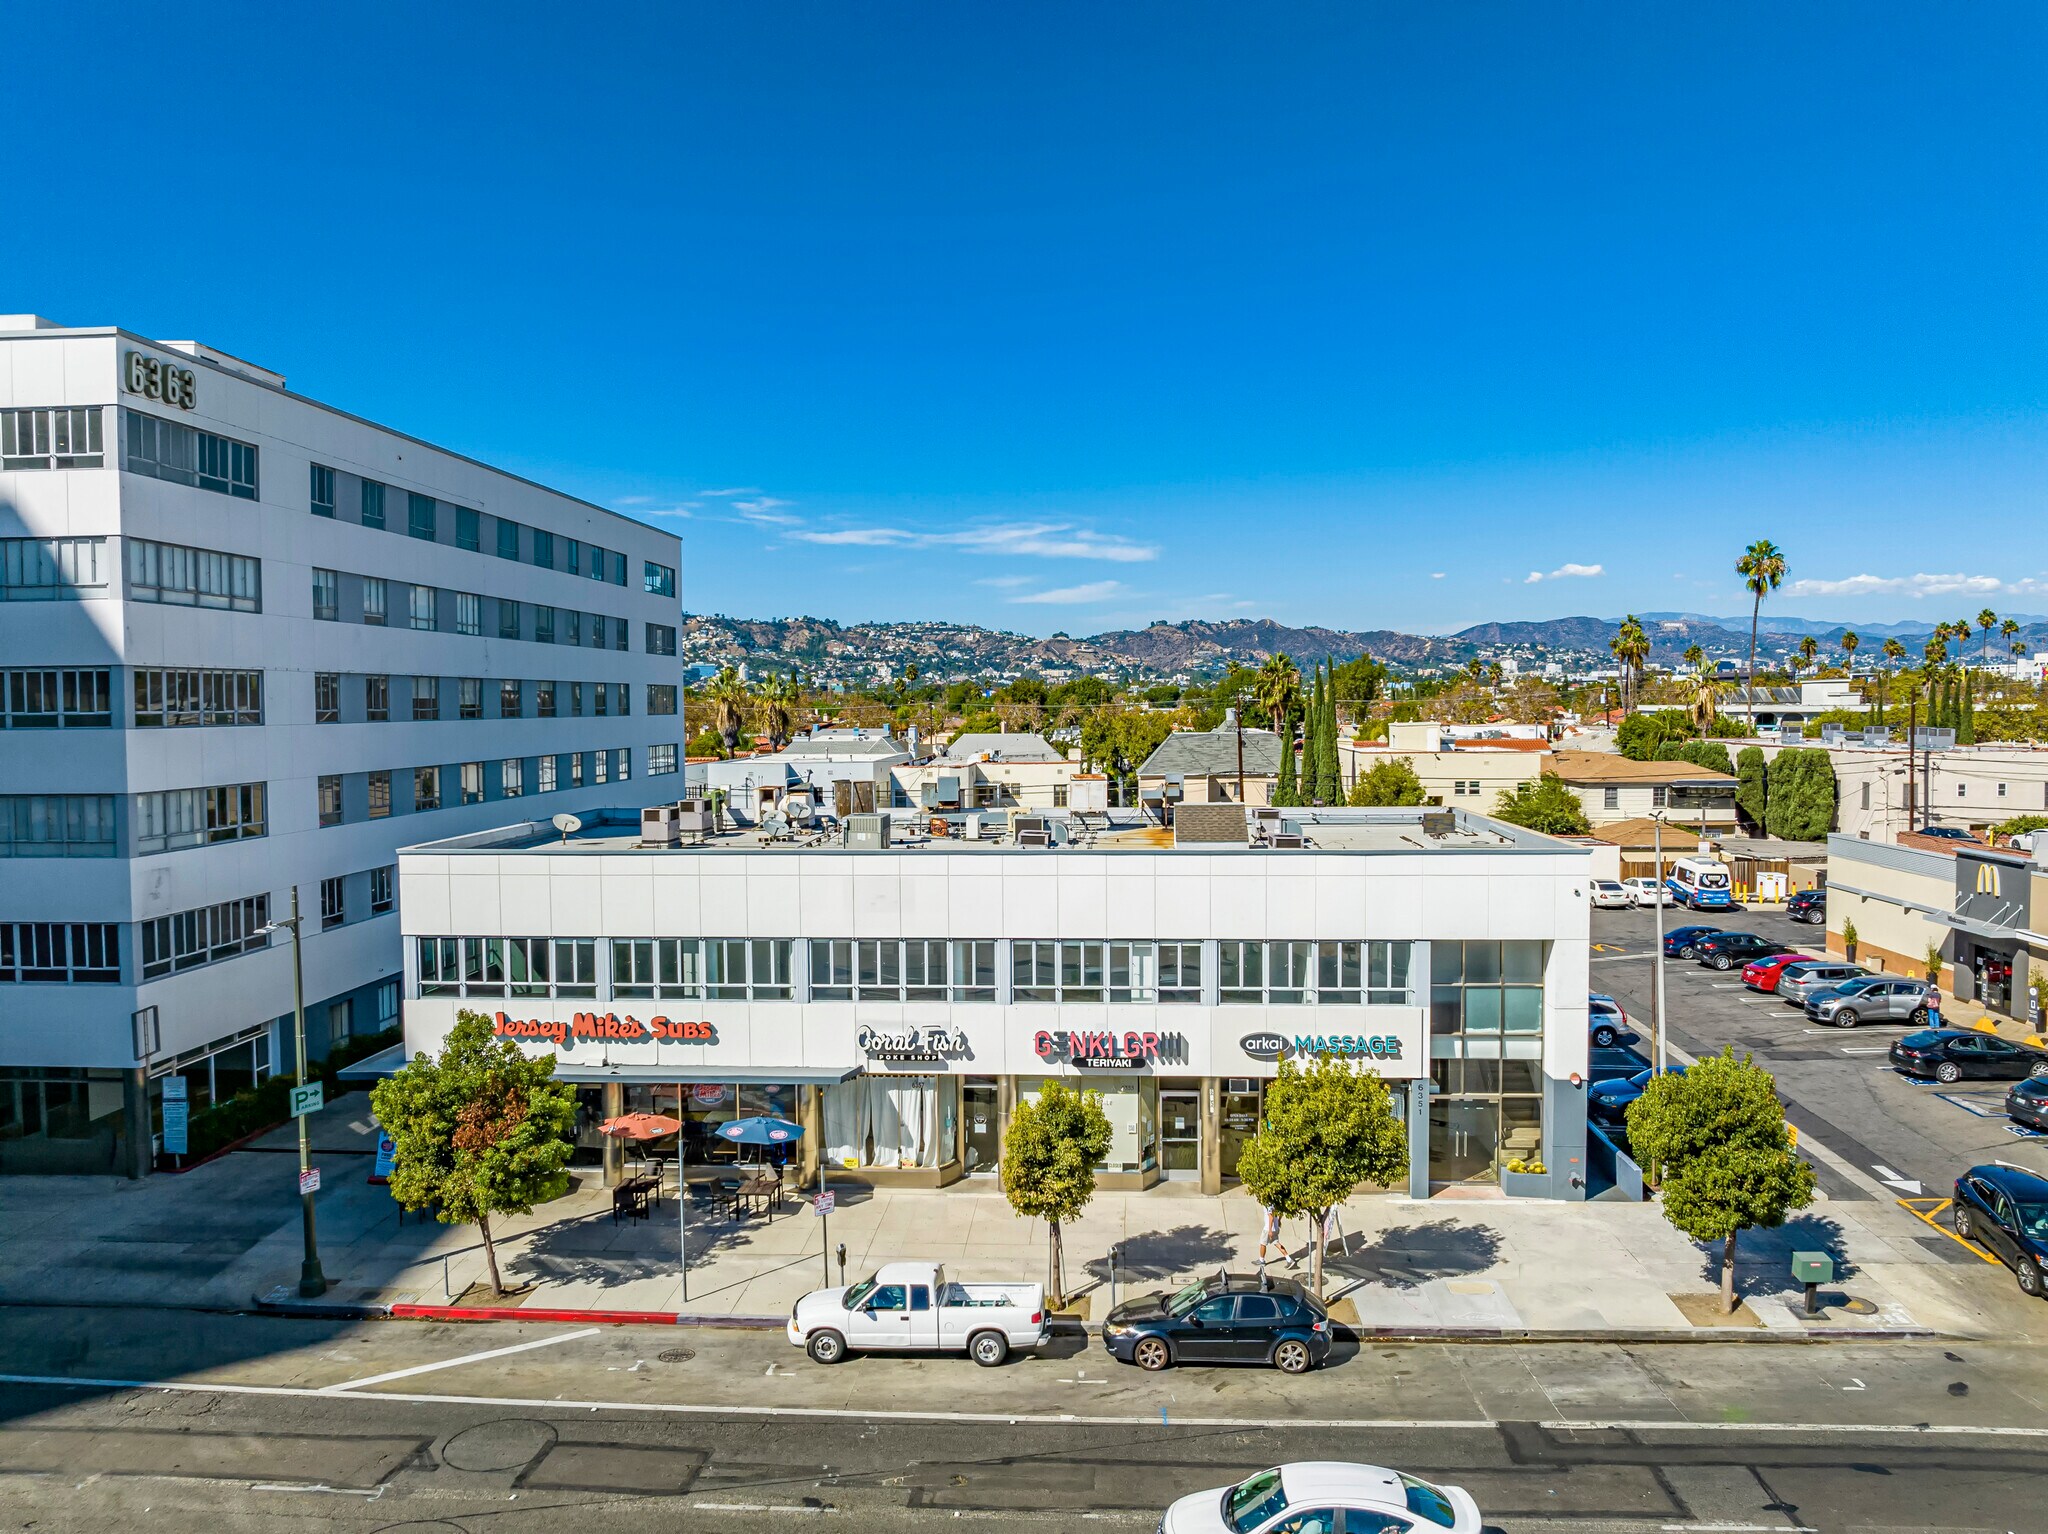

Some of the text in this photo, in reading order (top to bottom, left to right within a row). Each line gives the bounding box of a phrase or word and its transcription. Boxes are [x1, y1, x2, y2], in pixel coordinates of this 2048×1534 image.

[125, 351, 196, 409] 6363
[494, 1012, 567, 1044] Jersey
[571, 1013, 647, 1039] Mike's
[855, 1024, 966, 1052] Coral Fish
[1245, 1035, 1399, 1053] arkai MASSAGE
[1086, 1058, 1132, 1068] TERIYAKI
